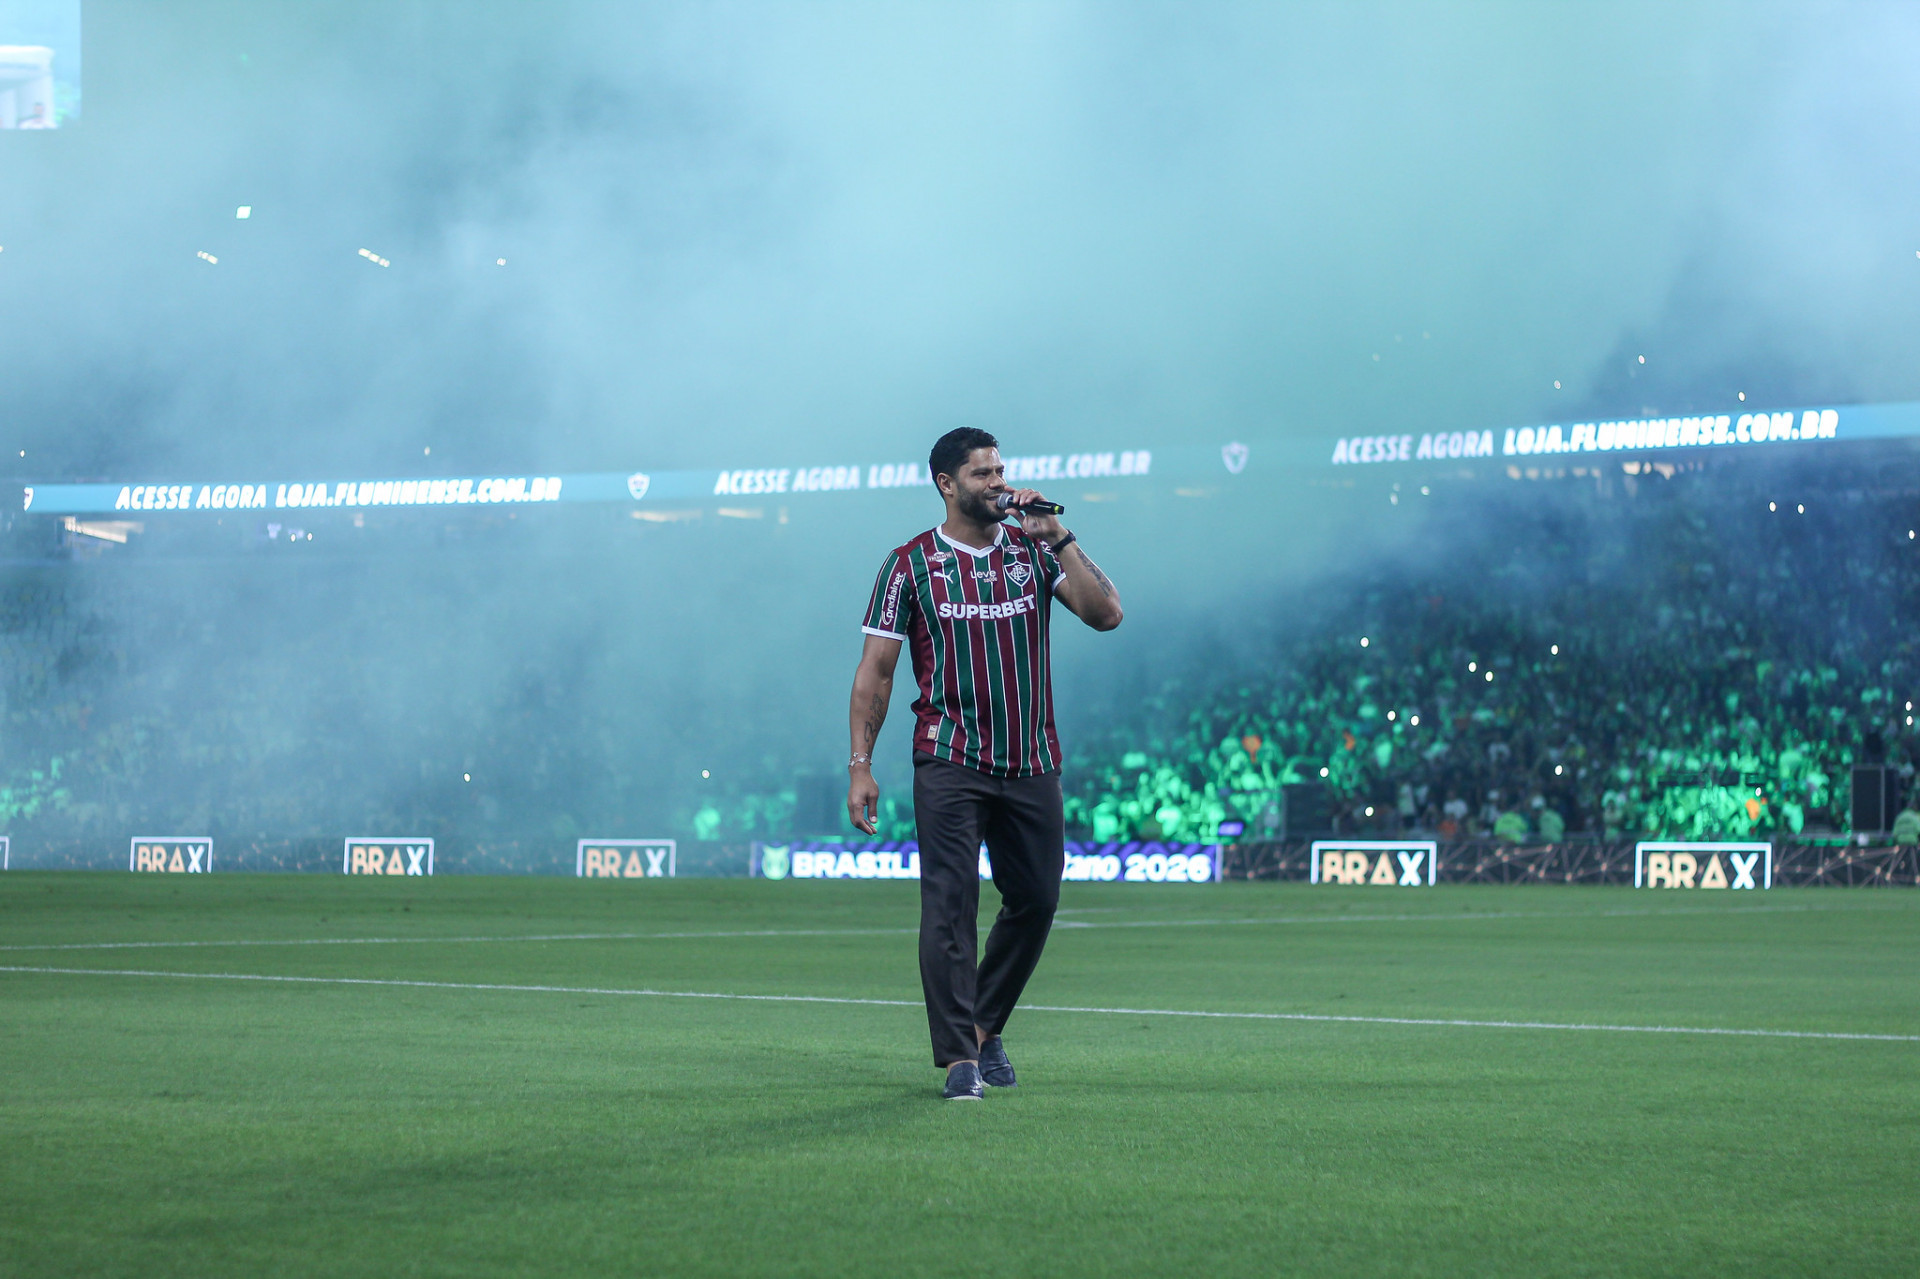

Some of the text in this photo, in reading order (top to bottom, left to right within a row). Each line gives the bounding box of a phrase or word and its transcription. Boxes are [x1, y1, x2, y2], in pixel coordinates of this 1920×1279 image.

[1331, 409, 1839, 465] ACESSE AGORA LOJA.FLUMINENSE.COM.BR
[115, 477, 562, 510] ACESSE AGORA LOJA.FLUMINENSE.COM.BR
[714, 468, 791, 495] ACESSE
[792, 465, 860, 492] AGORA
[970, 570, 997, 579] Leve
[886, 572, 904, 619] predialnet
[939, 594, 1035, 619] SUPERBET
[137, 845, 205, 873] BRAX
[352, 846, 425, 876] BRAX
[586, 848, 666, 877] BRAX
[1124, 853, 1212, 882] 2026
[1322, 851, 1425, 886] BRAX
[1647, 852, 1759, 889] BRAX
